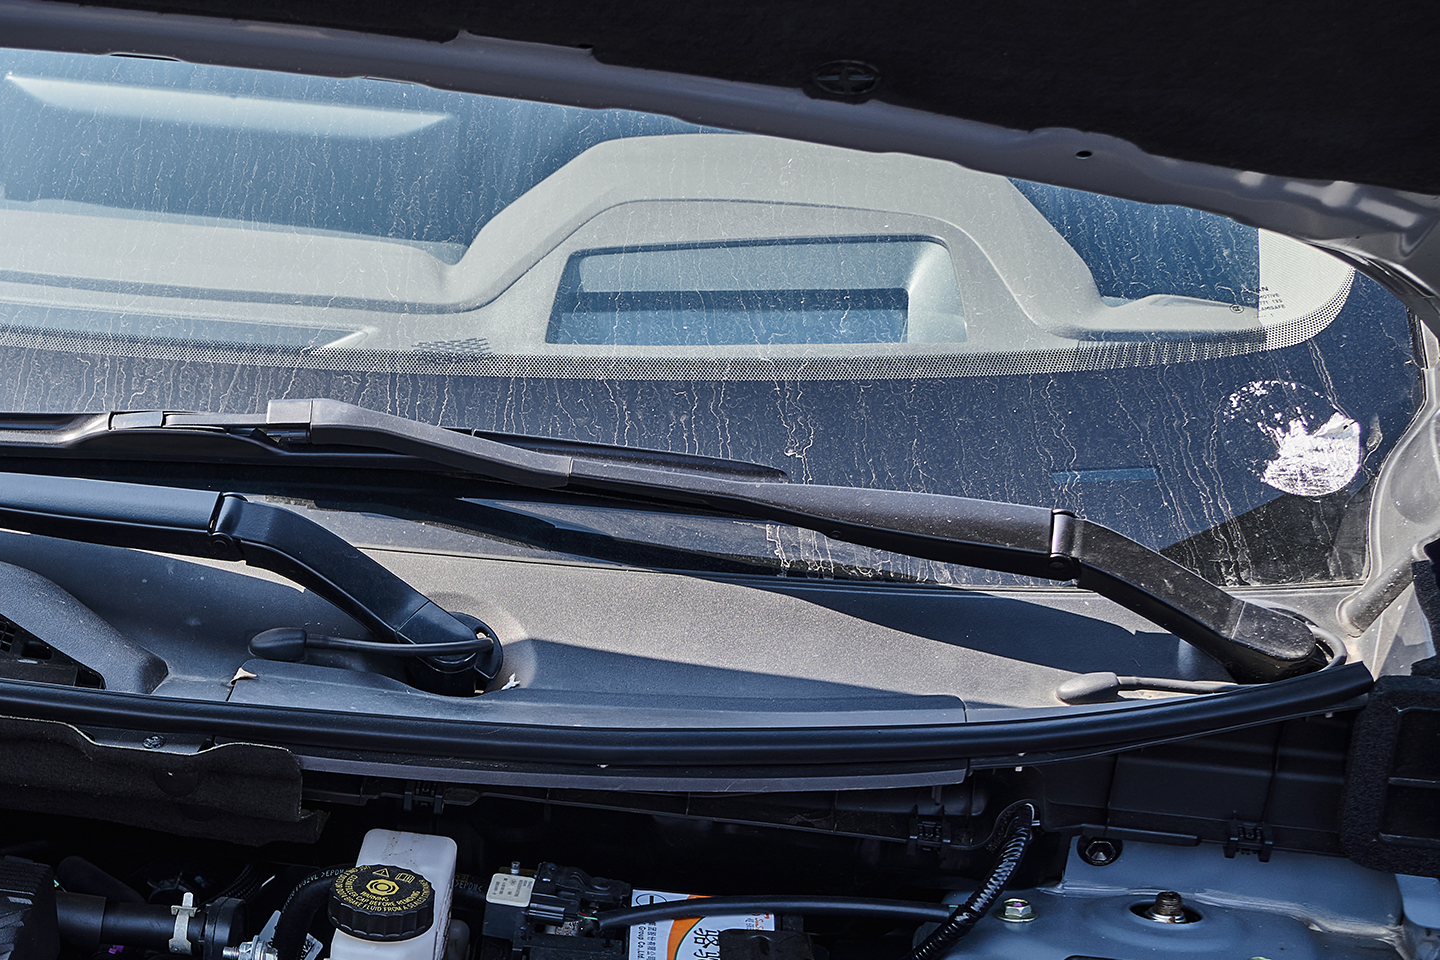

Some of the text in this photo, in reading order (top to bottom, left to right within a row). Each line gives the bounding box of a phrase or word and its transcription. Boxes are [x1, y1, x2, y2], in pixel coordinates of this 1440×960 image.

[359, 891, 390, 901] WARNING
[369, 899, 397, 907] BEFORE
[396, 890, 421, 905] REMOVING
[362, 904, 383, 912] FLUID
[637, 926, 647, 941] Group
